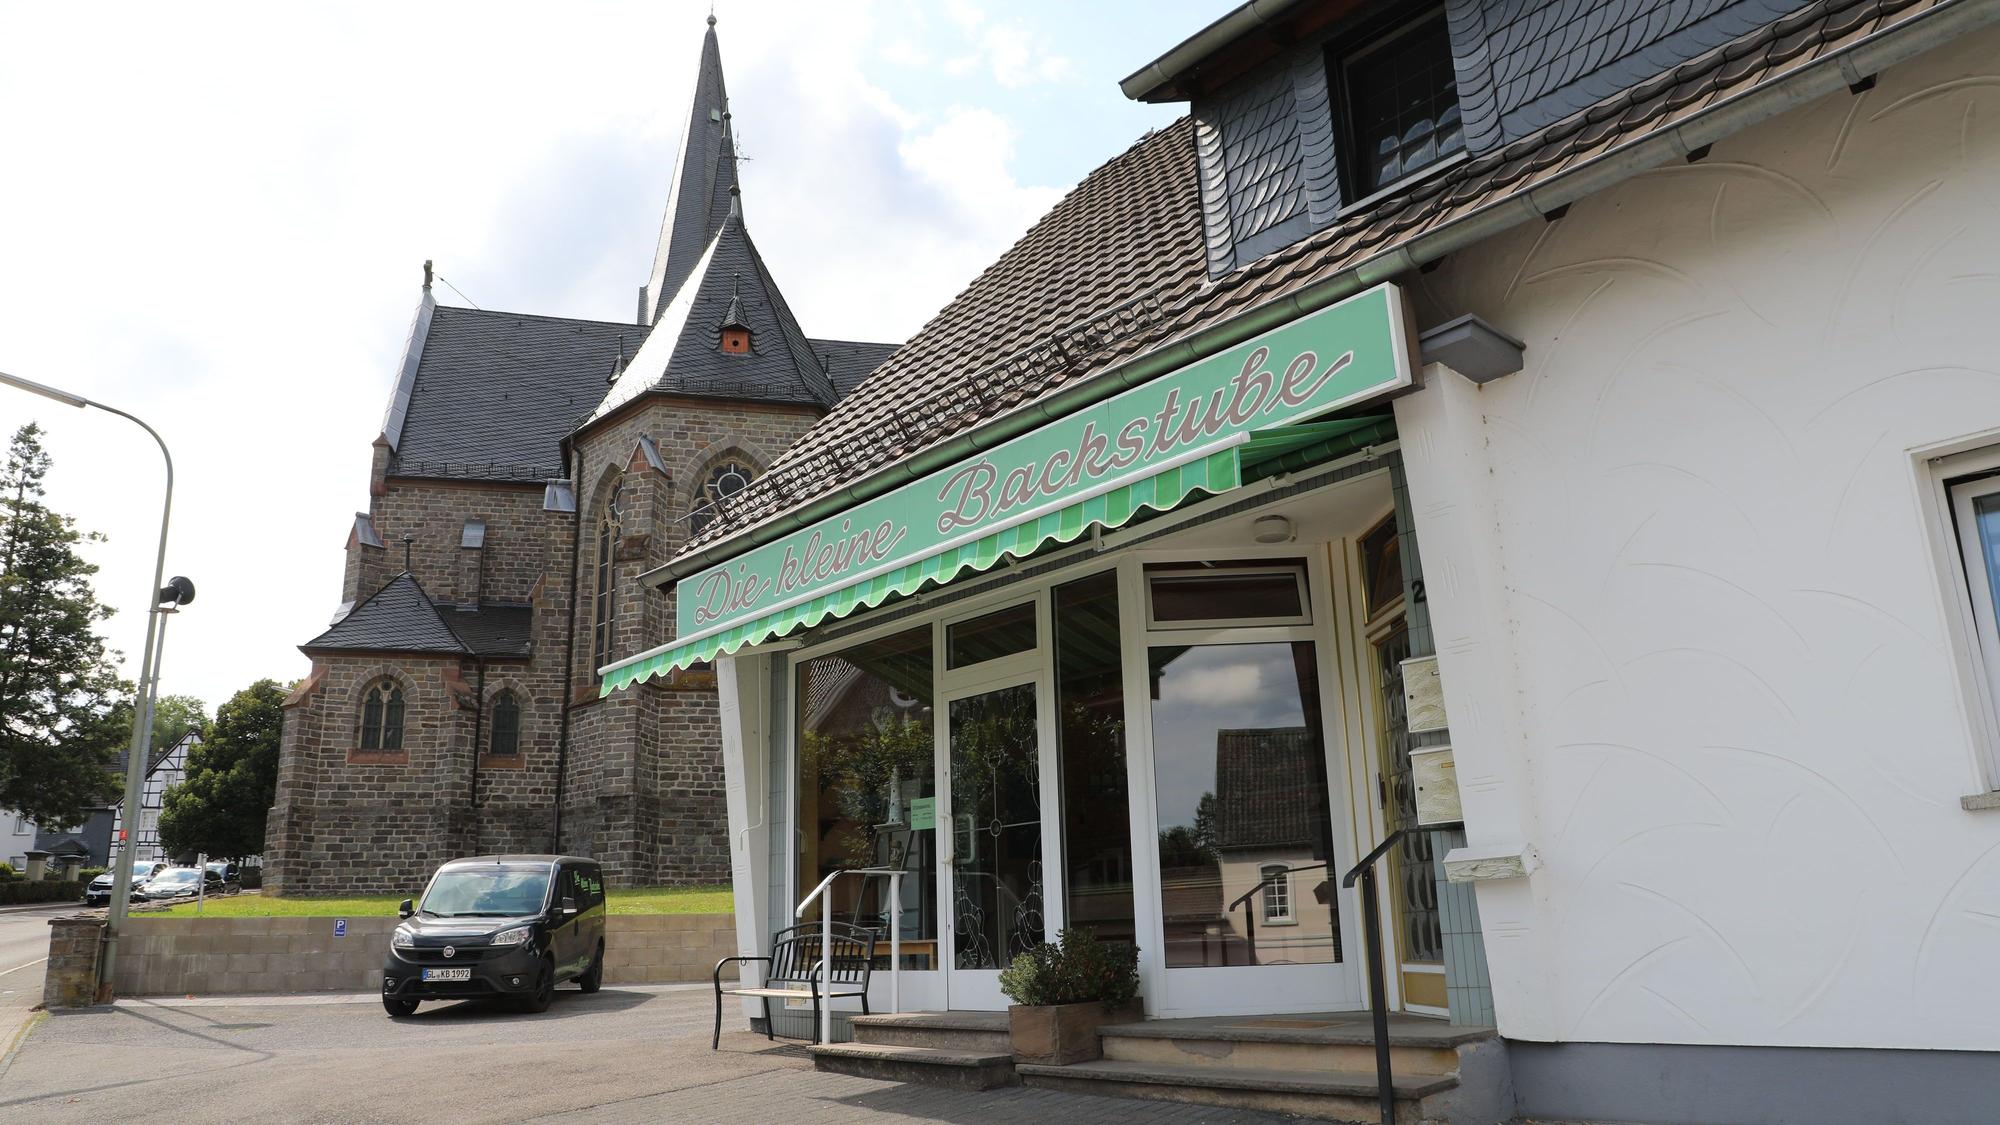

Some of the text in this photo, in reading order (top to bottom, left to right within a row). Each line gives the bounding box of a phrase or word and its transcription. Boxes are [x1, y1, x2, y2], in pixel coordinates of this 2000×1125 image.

[694, 345, 1354, 625] Die kleine Backstube
[427, 970, 469, 978] GL KB 1992
